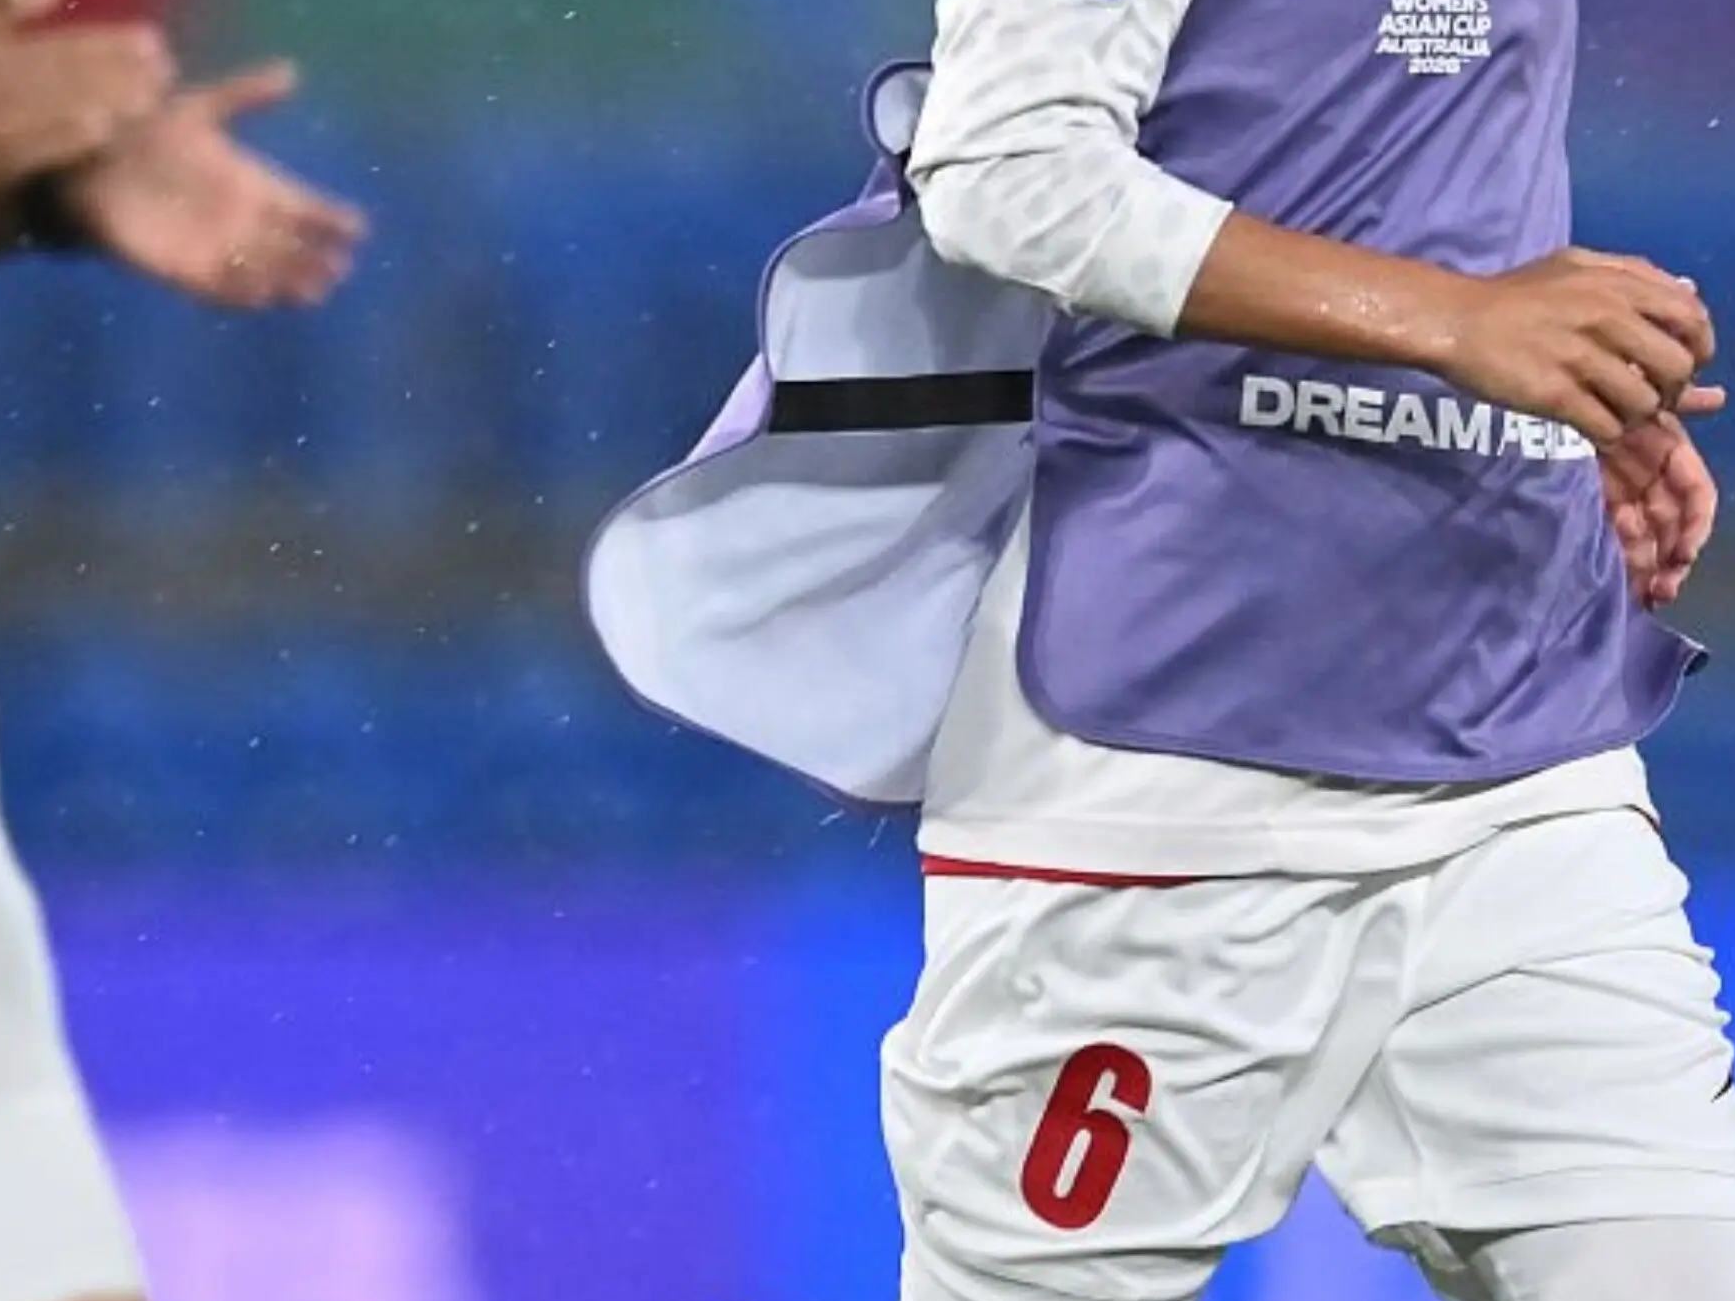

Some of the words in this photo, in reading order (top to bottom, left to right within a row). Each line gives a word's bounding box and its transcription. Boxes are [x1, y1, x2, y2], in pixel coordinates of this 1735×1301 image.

[1375, 37, 1492, 56] AUSTRALIA
[1377, 13, 1451, 35] ASIAN
[1453, 14, 1491, 36] CUP
[1239, 375, 1492, 456] DREAM
[1021, 1042, 1152, 1230] 6
